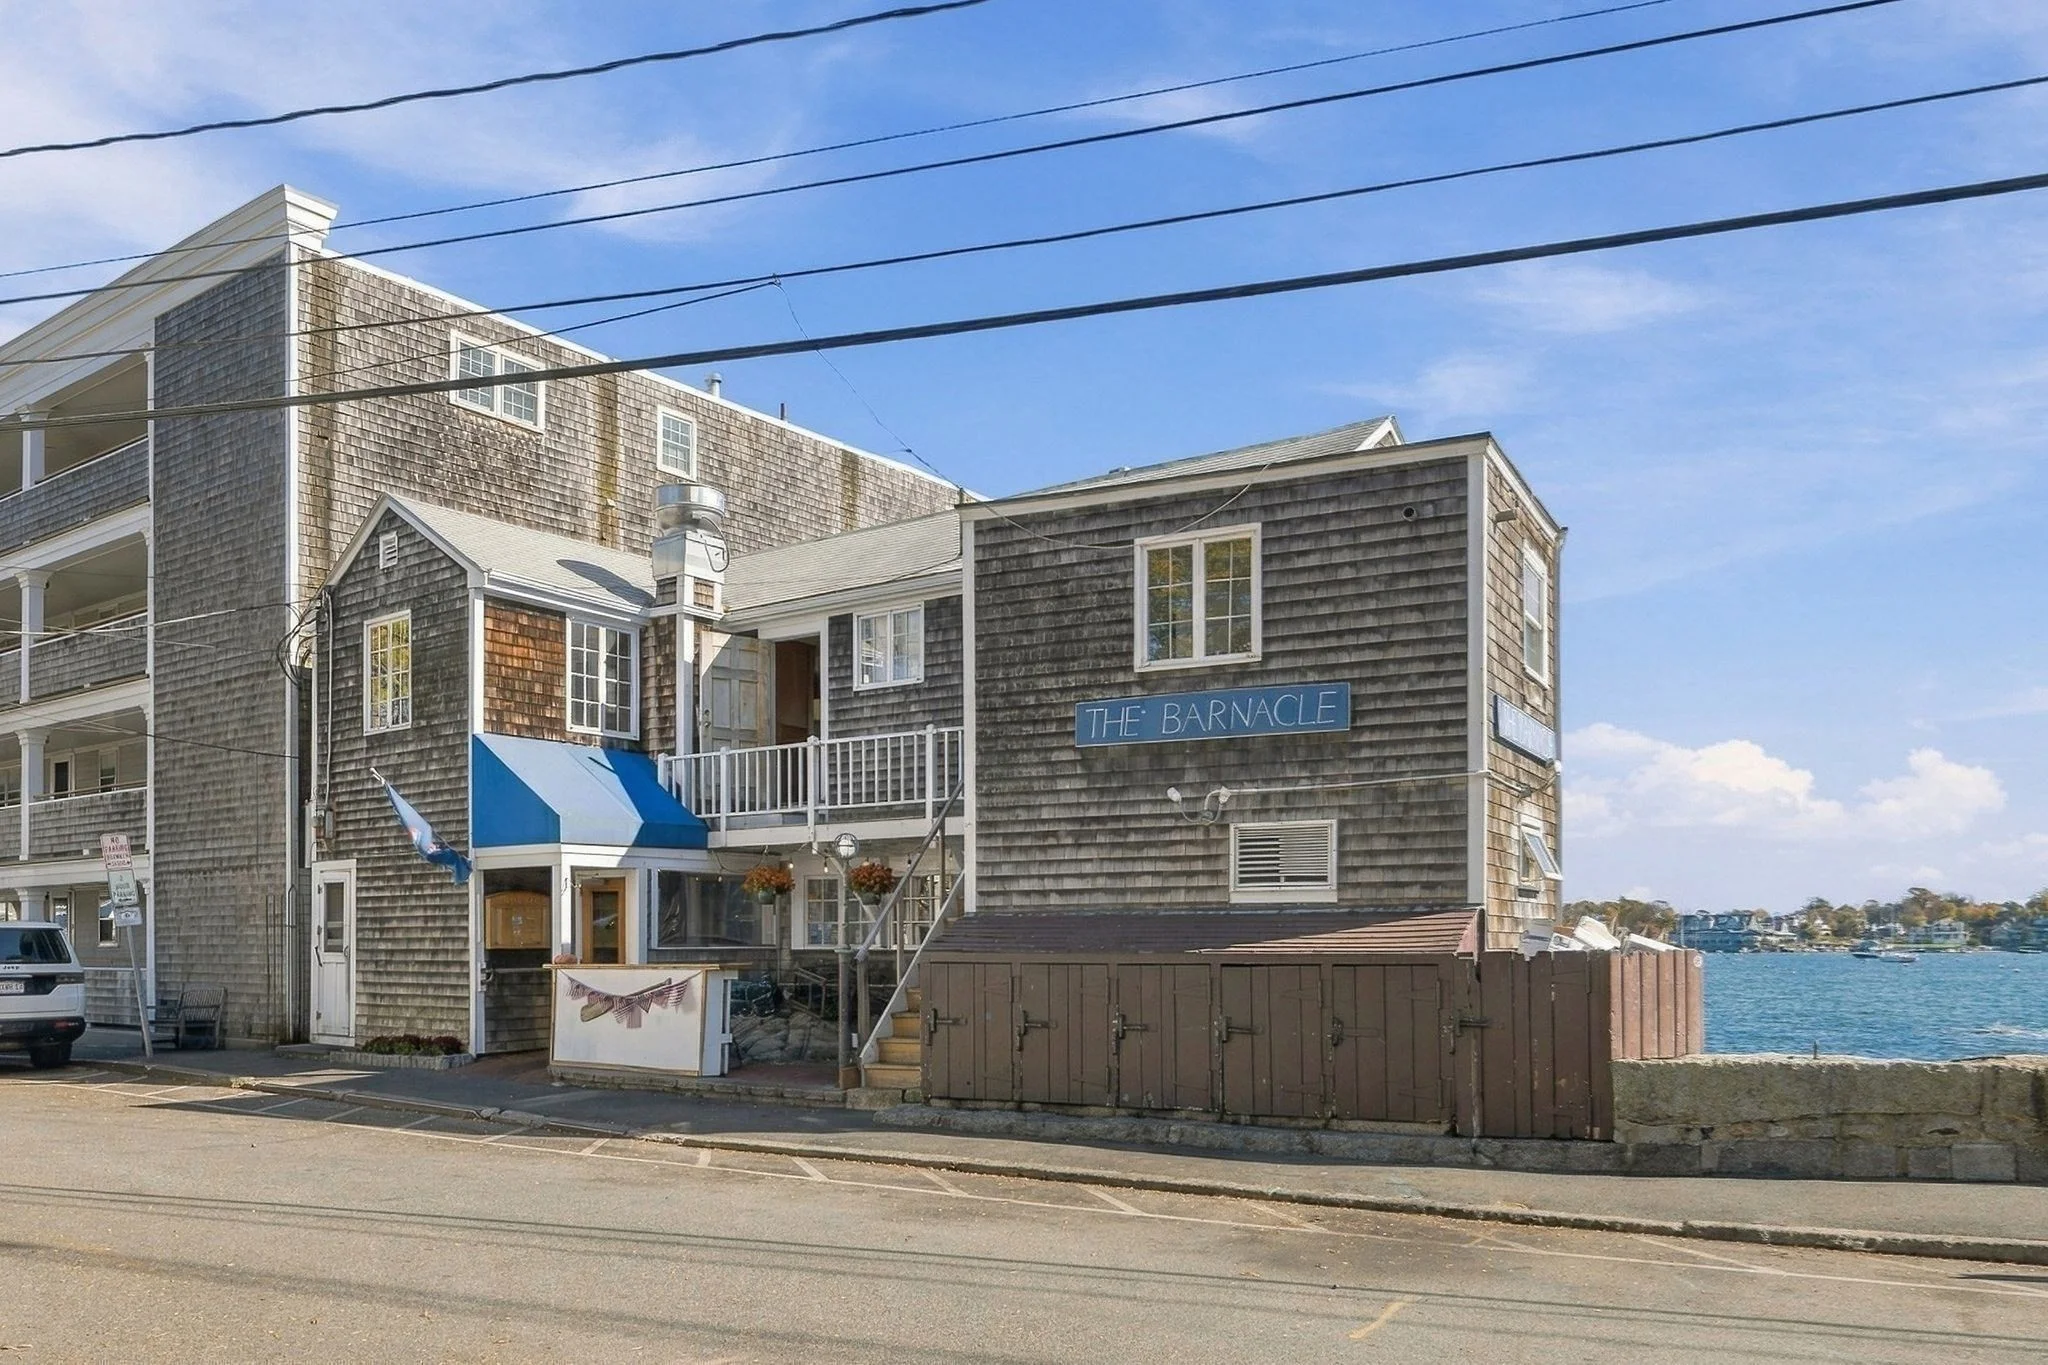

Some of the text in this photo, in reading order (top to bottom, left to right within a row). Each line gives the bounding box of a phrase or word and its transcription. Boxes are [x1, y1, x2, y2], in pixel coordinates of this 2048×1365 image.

[1085, 691, 1337, 739] THE BARNACLE
[110, 836, 120, 844] NO
